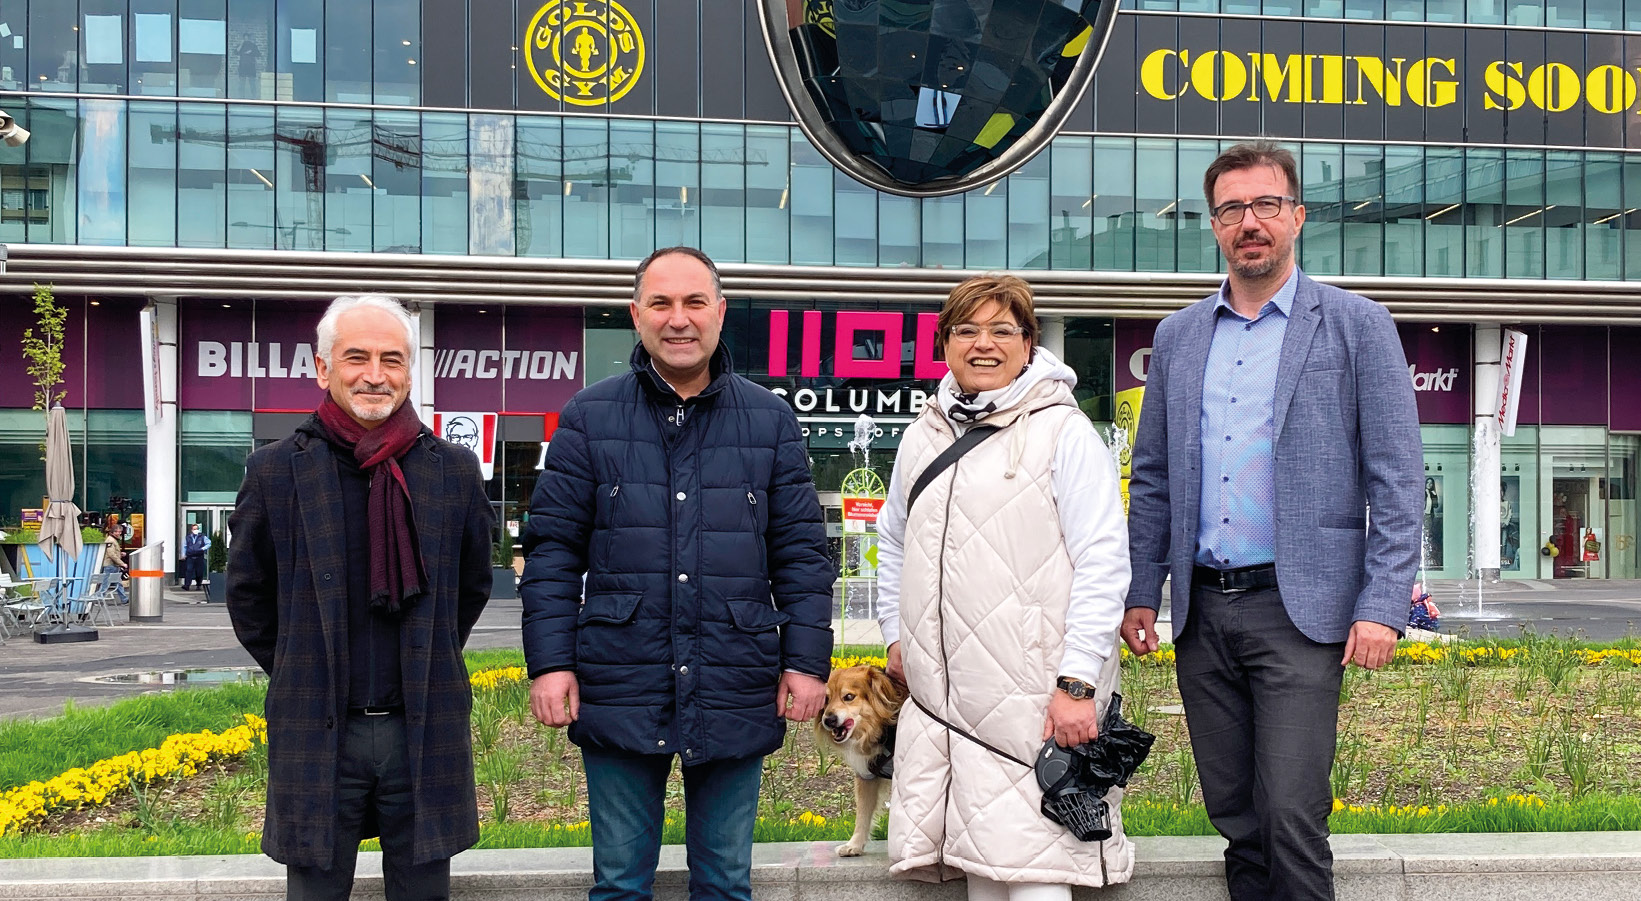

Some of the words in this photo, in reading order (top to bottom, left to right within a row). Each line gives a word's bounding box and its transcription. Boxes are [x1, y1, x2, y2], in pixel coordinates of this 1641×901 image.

[536, 2, 635, 53] GOLD'S
[545, 66, 630, 96] GYM
[1140, 48, 1460, 108] COMING
[1484, 60, 1641, 114] SOO
[198, 341, 318, 379] BILLA
[449, 349, 578, 380] ACTION
[802, 427, 843, 437] OPS
